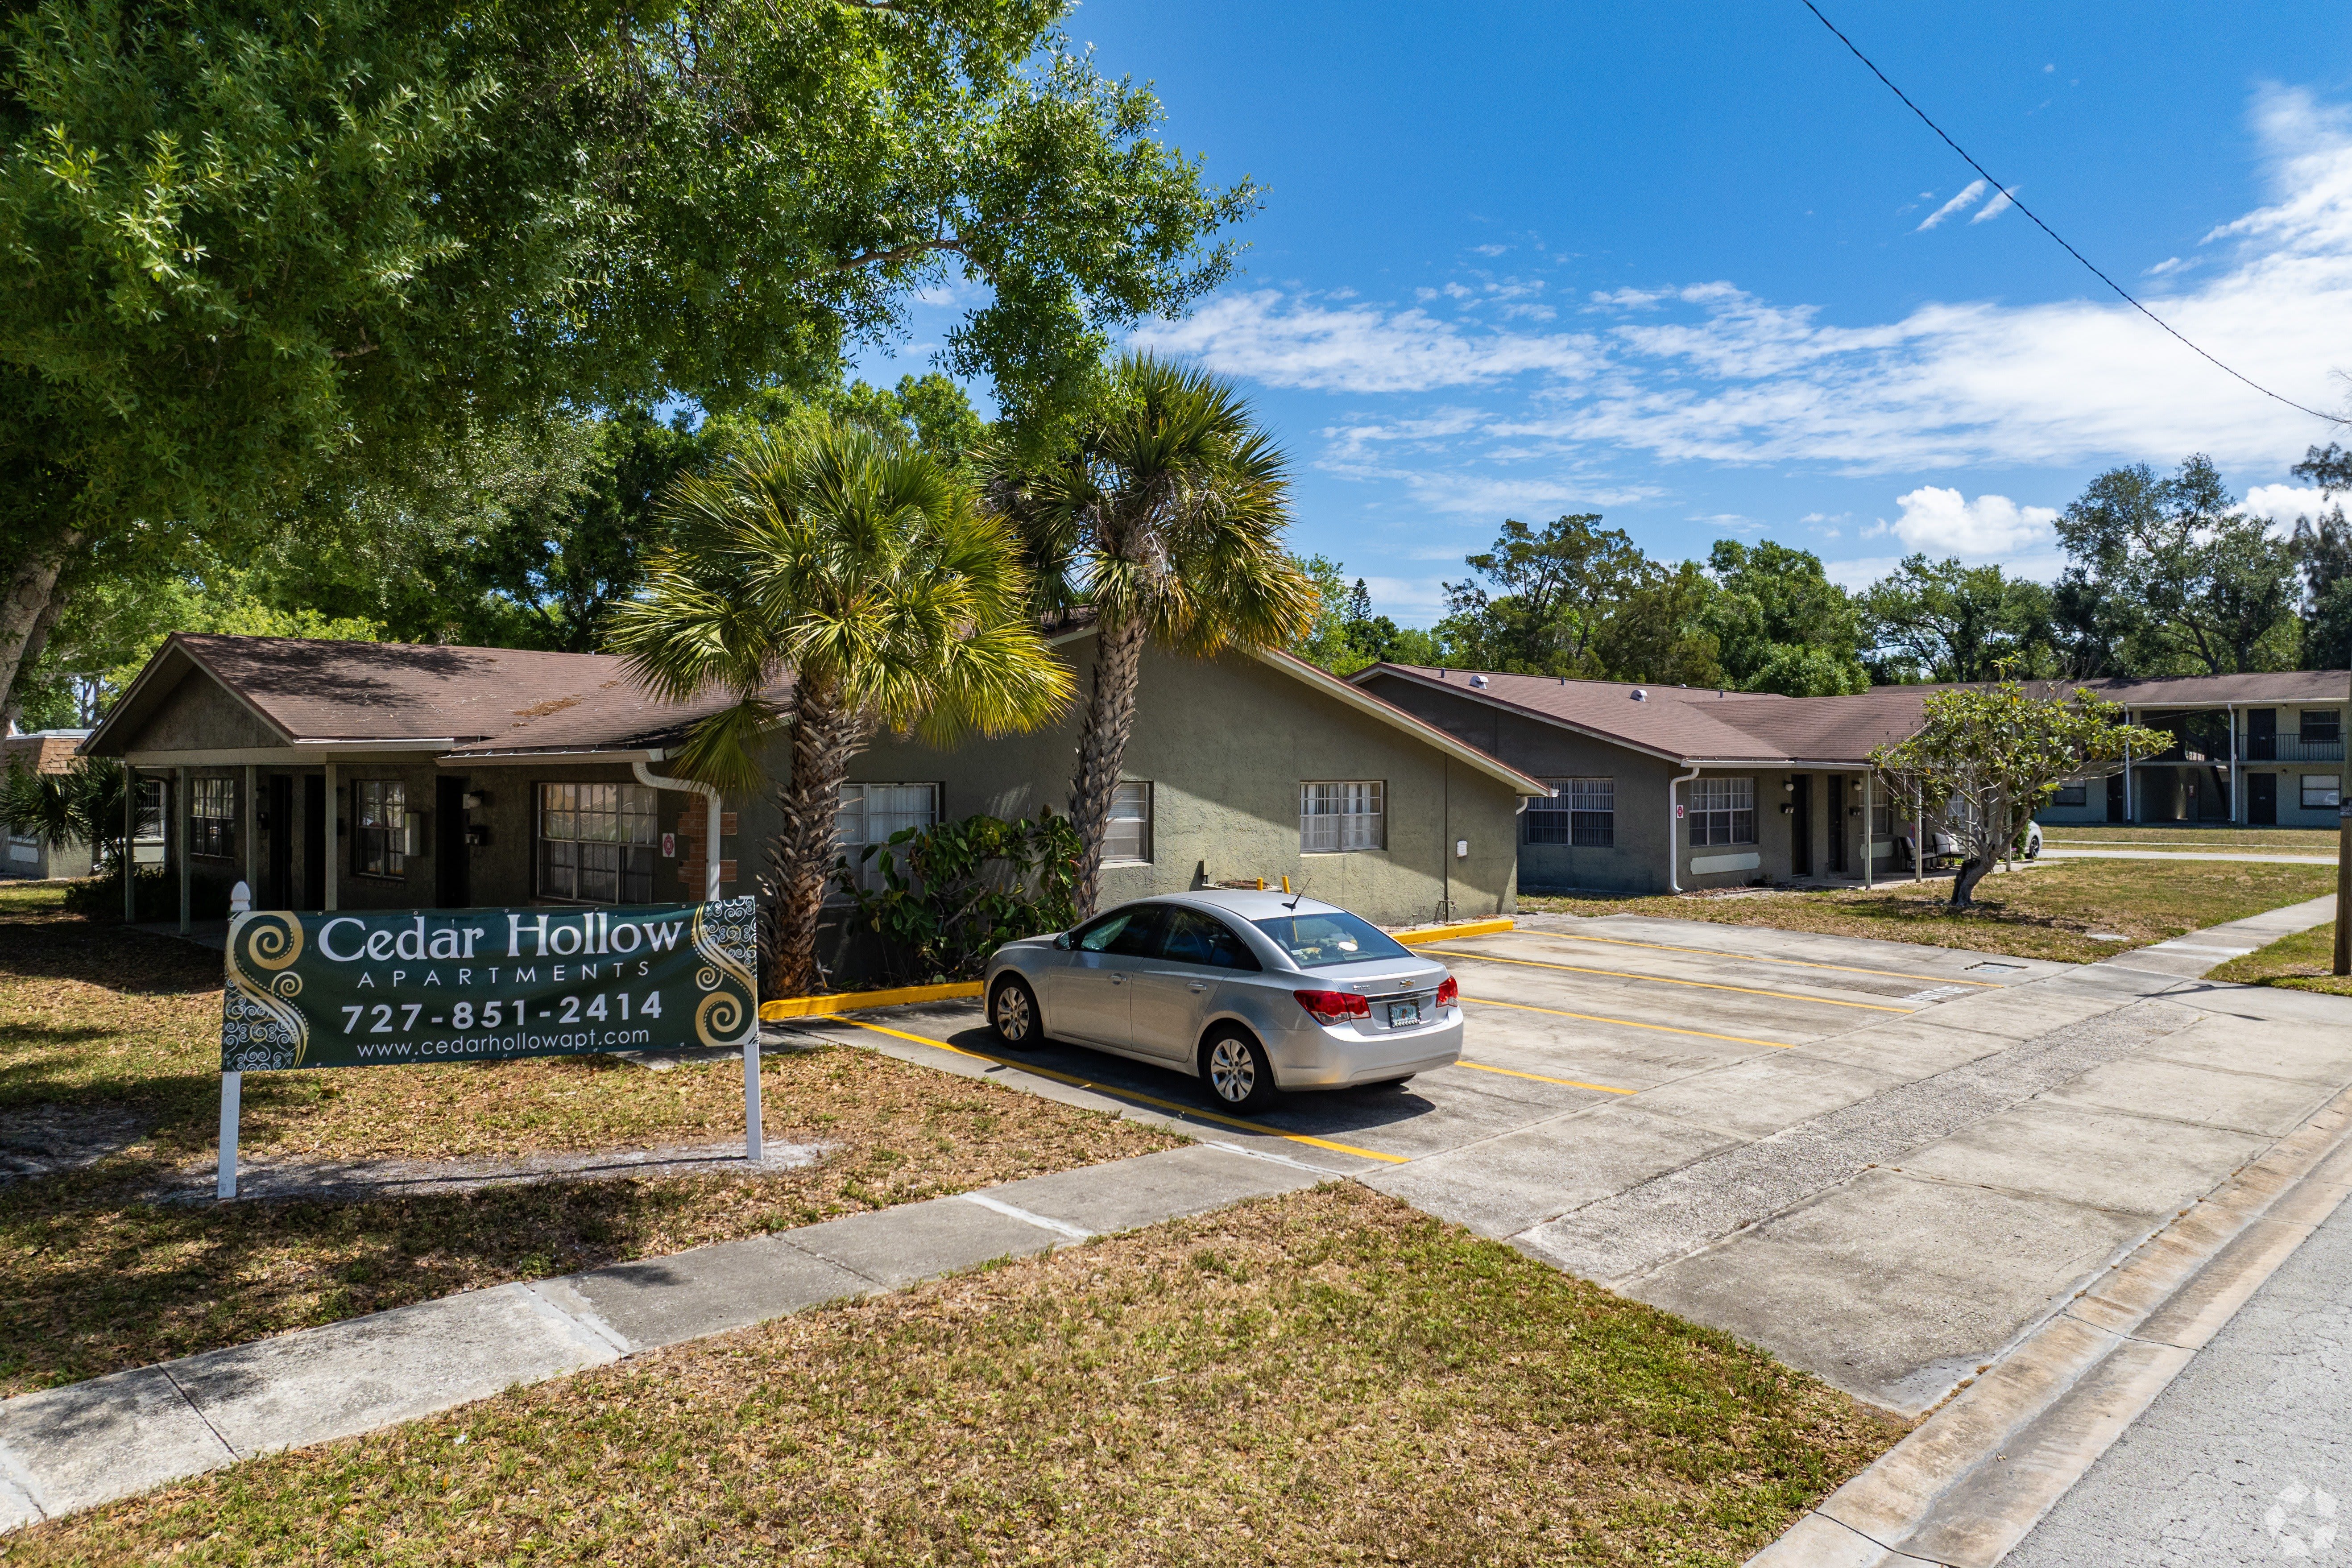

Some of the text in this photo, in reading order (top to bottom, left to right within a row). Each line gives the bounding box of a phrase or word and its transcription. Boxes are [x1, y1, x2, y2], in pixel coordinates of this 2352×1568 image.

[318, 912, 683, 962] Cedar Hollow
[357, 960, 649, 989] APARTMENTS
[342, 990, 662, 1034] 727-851-2414
[357, 1029, 649, 1057] www.cedarhollowapt.com
